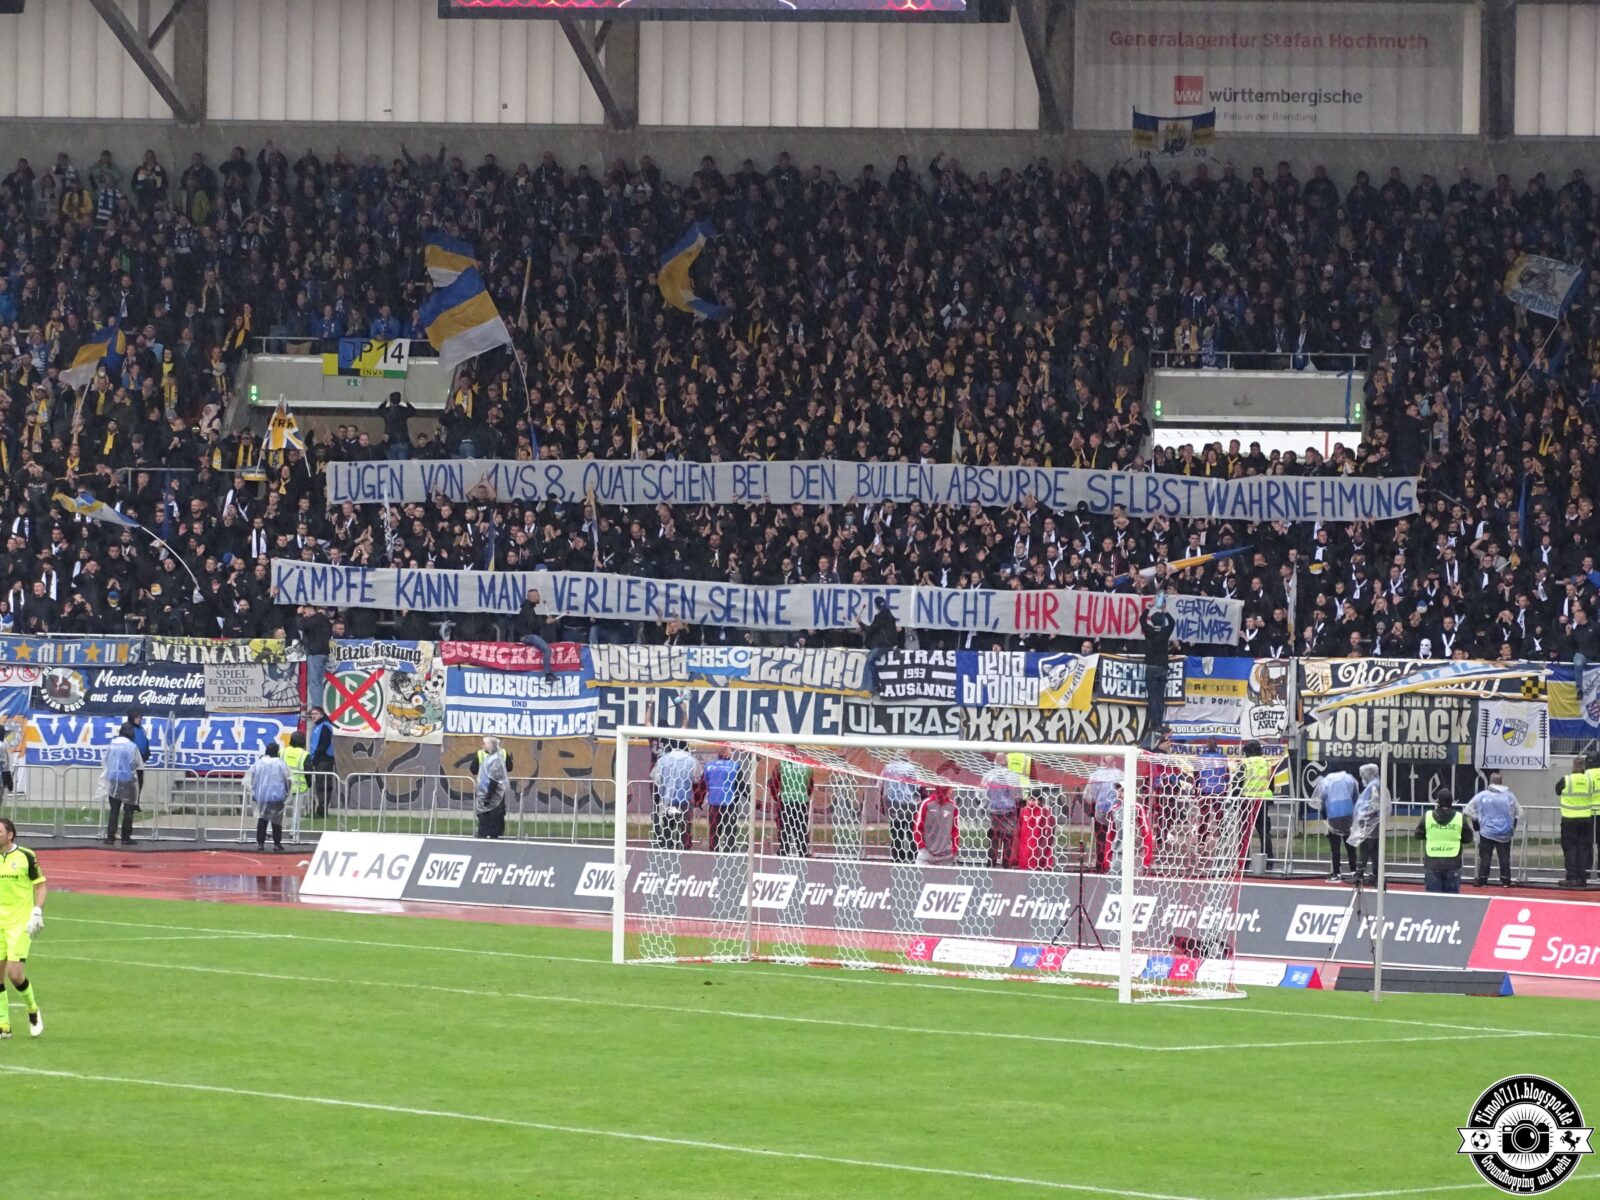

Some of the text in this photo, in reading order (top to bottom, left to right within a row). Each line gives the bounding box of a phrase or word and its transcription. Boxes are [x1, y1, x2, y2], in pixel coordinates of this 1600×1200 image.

[1109, 30, 1428, 50] Generalagentur Stefan Hochmuth
[1209, 87, 1362, 107] württembergische
[334, 462, 404, 500] LÜGEN
[420, 463, 464, 500] VON
[583, 461, 717, 502] QUATSCHEN
[733, 464, 769, 500] BEI
[790, 464, 837, 501] DEN
[947, 464, 1069, 508] ABSURDE
[277, 565, 377, 605] KÄMPFE
[396, 571, 459, 608] KANN
[478, 574, 527, 612] MAN
[916, 591, 1000, 631] NICHT,
[1014, 592, 1060, 632] IHR
[38, 642, 82, 664] MIT
[104, 642, 142, 664] UNS
[152, 641, 254, 664] WEIMAR
[336, 642, 422, 665] Letzte Festung
[95, 669, 205, 689] Menschenrechte
[216, 669, 248, 679] SPIEL
[464, 671, 580, 697] UNBEUGSAM
[903, 668, 926, 680] 1993
[90, 692, 108, 703] aus
[112, 690, 134, 704] dem
[138, 690, 179, 706] Abseits
[217, 686, 248, 695] DEIN
[879, 682, 956, 698] AUSANNE
[511, 700, 527, 708] UND
[599, 687, 841, 736] SÜDKURVE
[849, 704, 961, 735] ULTRAS
[964, 704, 1148, 743] HARAKIRI
[1307, 707, 1472, 743] WOLFPACK
[36, 717, 282, 750] WEMAR
[1325, 743, 1354, 757] FCC
[1485, 755, 1544, 766] CHAOTEN
[1430, 823, 1457, 831] PRESSE
[425, 860, 556, 888] SWE Für Erfurt.
[633, 871, 665, 894] Für
[664, 874, 720, 898] Erfurt.
[751, 878, 893, 910] SWE Für Erfurt.
[922, 889, 966, 913] SWE
[976, 893, 1010, 917] Für
[1162, 903, 1195, 927] Für
[1196, 905, 1261, 932] Erfurt.
[1295, 912, 1342, 936] SWE
[1395, 916, 1462, 945] Erfurt.
